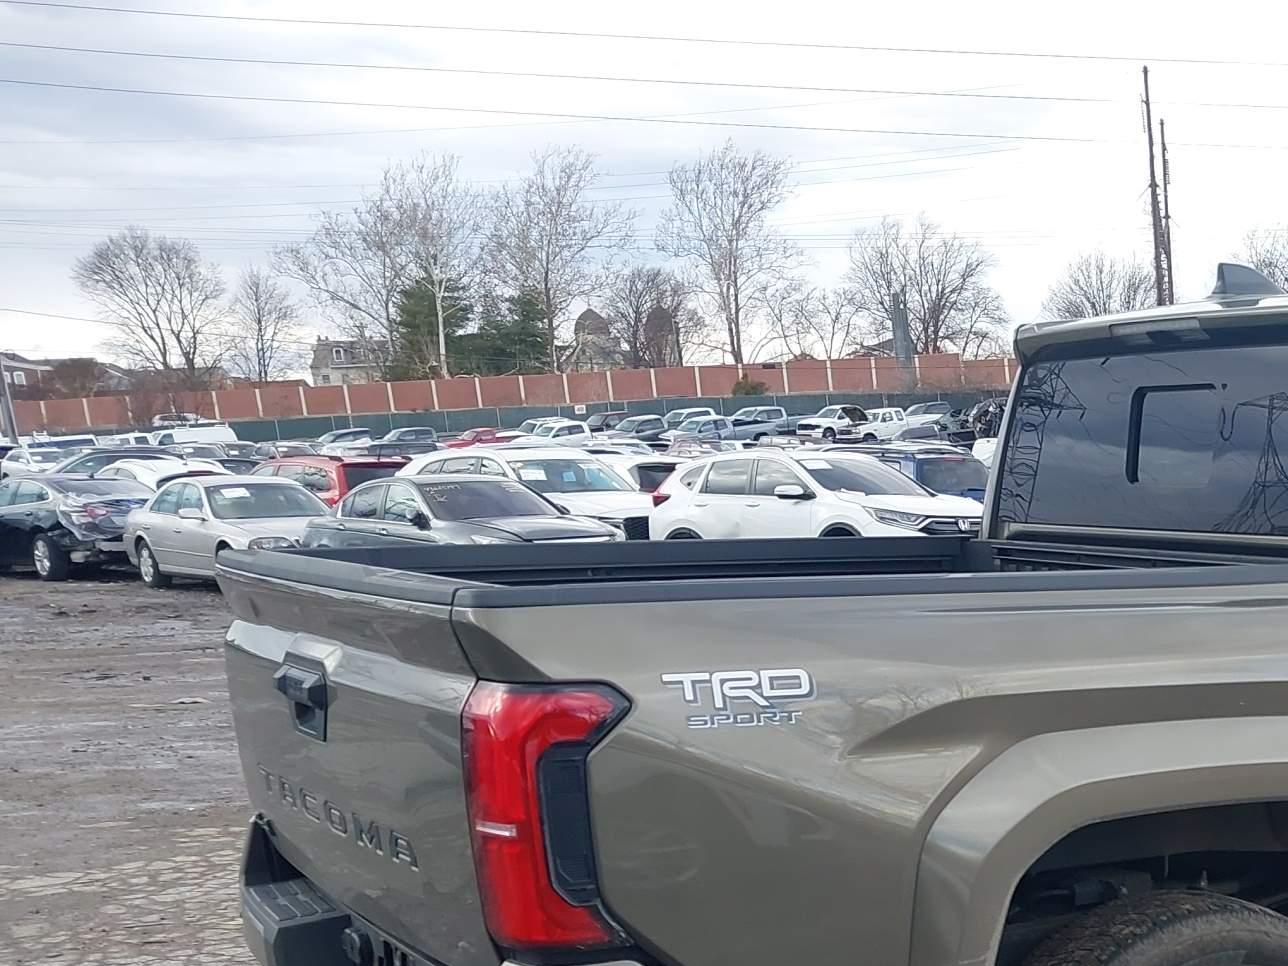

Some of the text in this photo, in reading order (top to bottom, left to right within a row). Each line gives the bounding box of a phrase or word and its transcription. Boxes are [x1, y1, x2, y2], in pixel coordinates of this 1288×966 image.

[661, 668, 812, 708] TRD
[687, 711, 803, 729] SPORT
[256, 762, 420, 873] TACOMA
